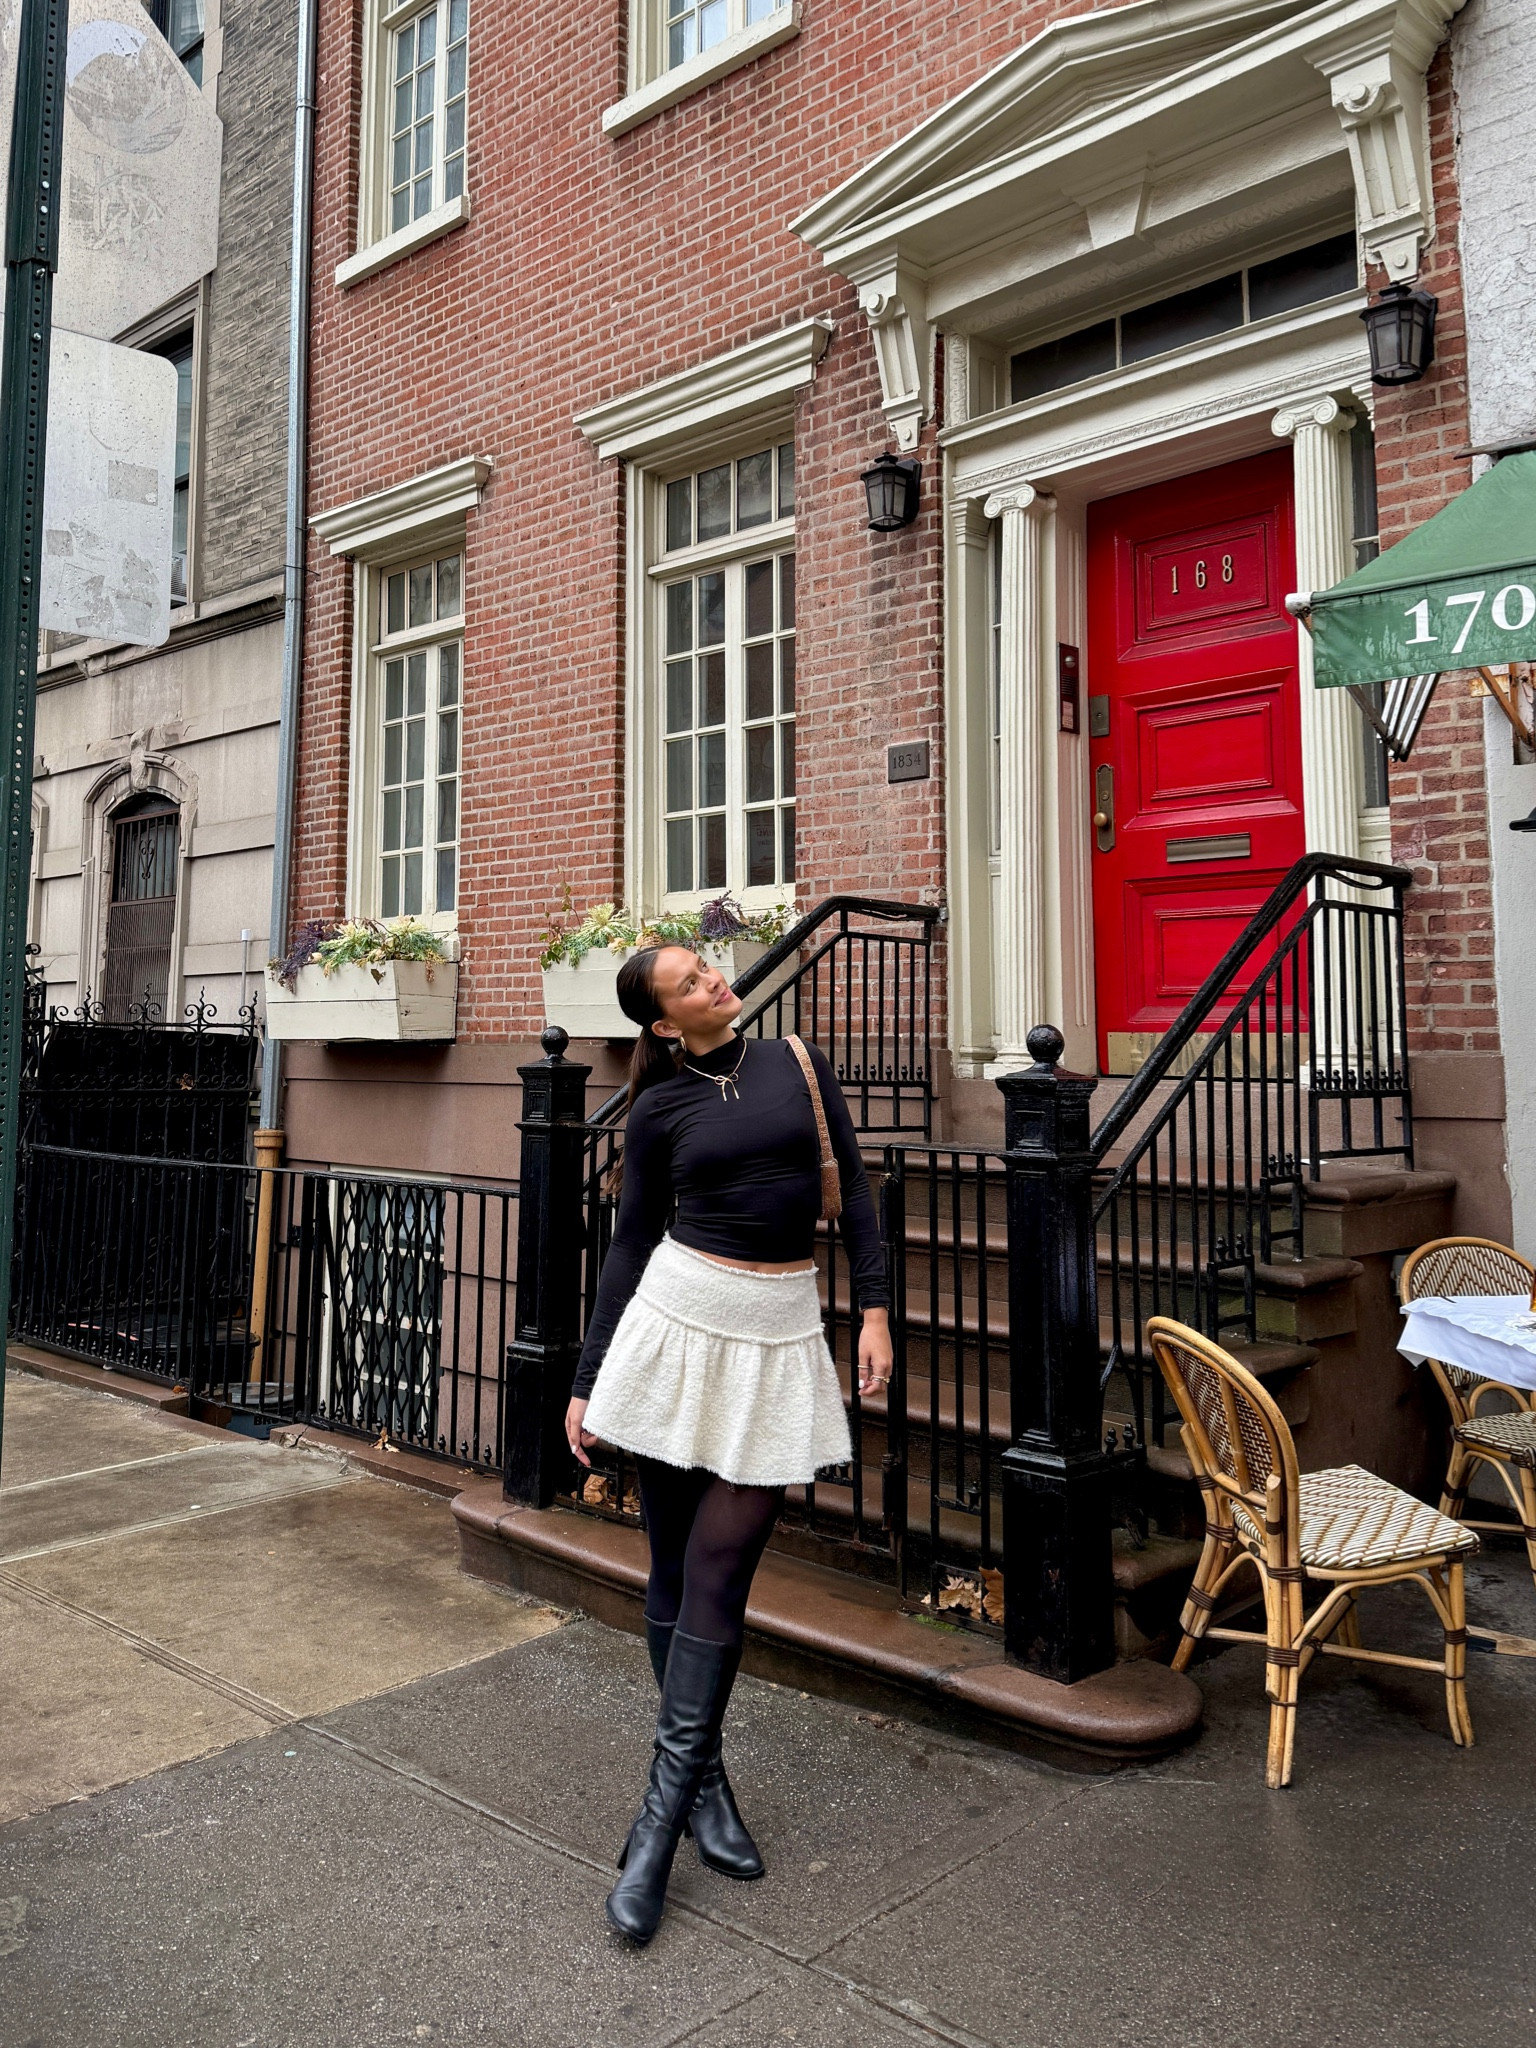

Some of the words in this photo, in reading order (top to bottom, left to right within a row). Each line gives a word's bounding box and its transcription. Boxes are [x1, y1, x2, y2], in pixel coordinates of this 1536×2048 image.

[1171, 554, 1233, 594] 168
[1404, 584, 1536, 654] 170
[893, 752, 922, 769] 1834
